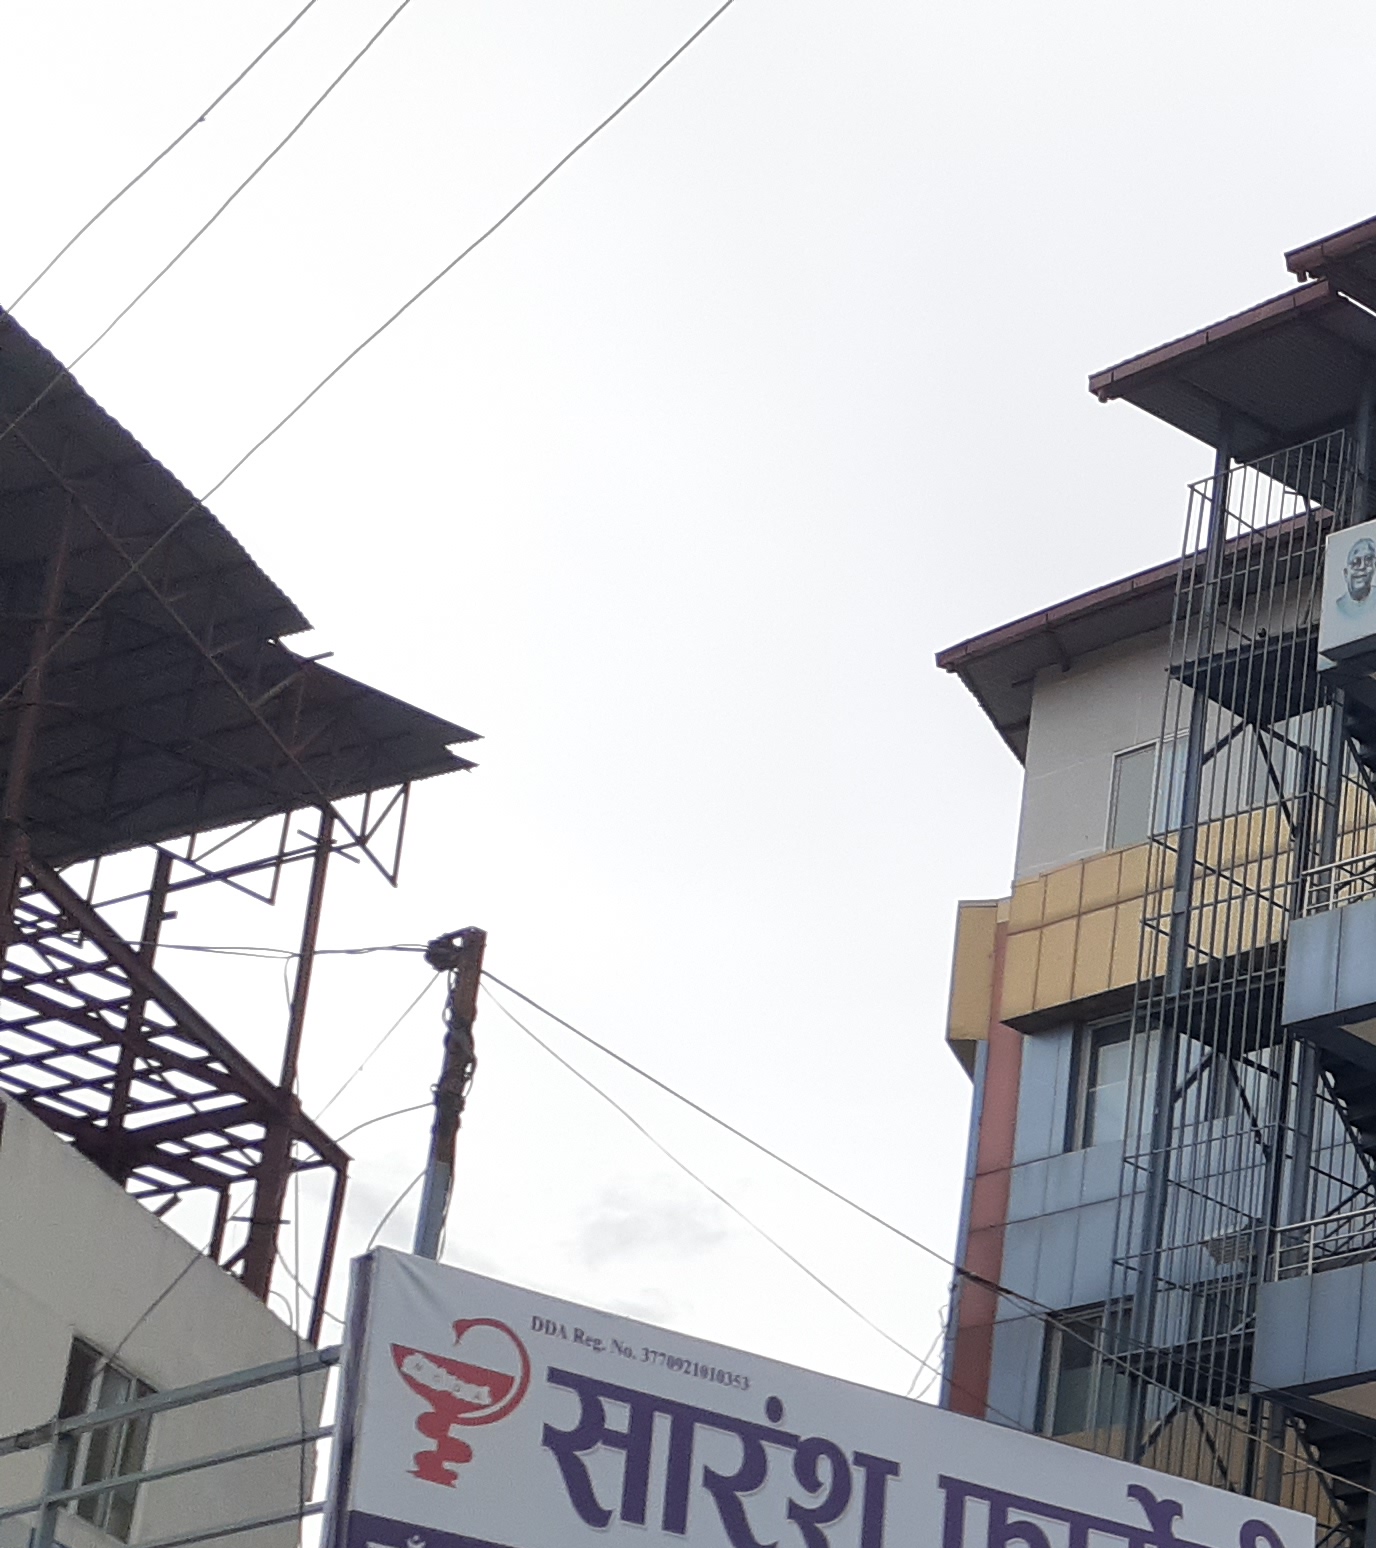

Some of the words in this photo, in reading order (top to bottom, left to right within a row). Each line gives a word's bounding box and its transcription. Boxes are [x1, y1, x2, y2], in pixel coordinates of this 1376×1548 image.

[531, 1315, 568, 1341] DDA
[573, 1327, 607, 1352] Reg.
[611, 1338, 637, 1360] No.
